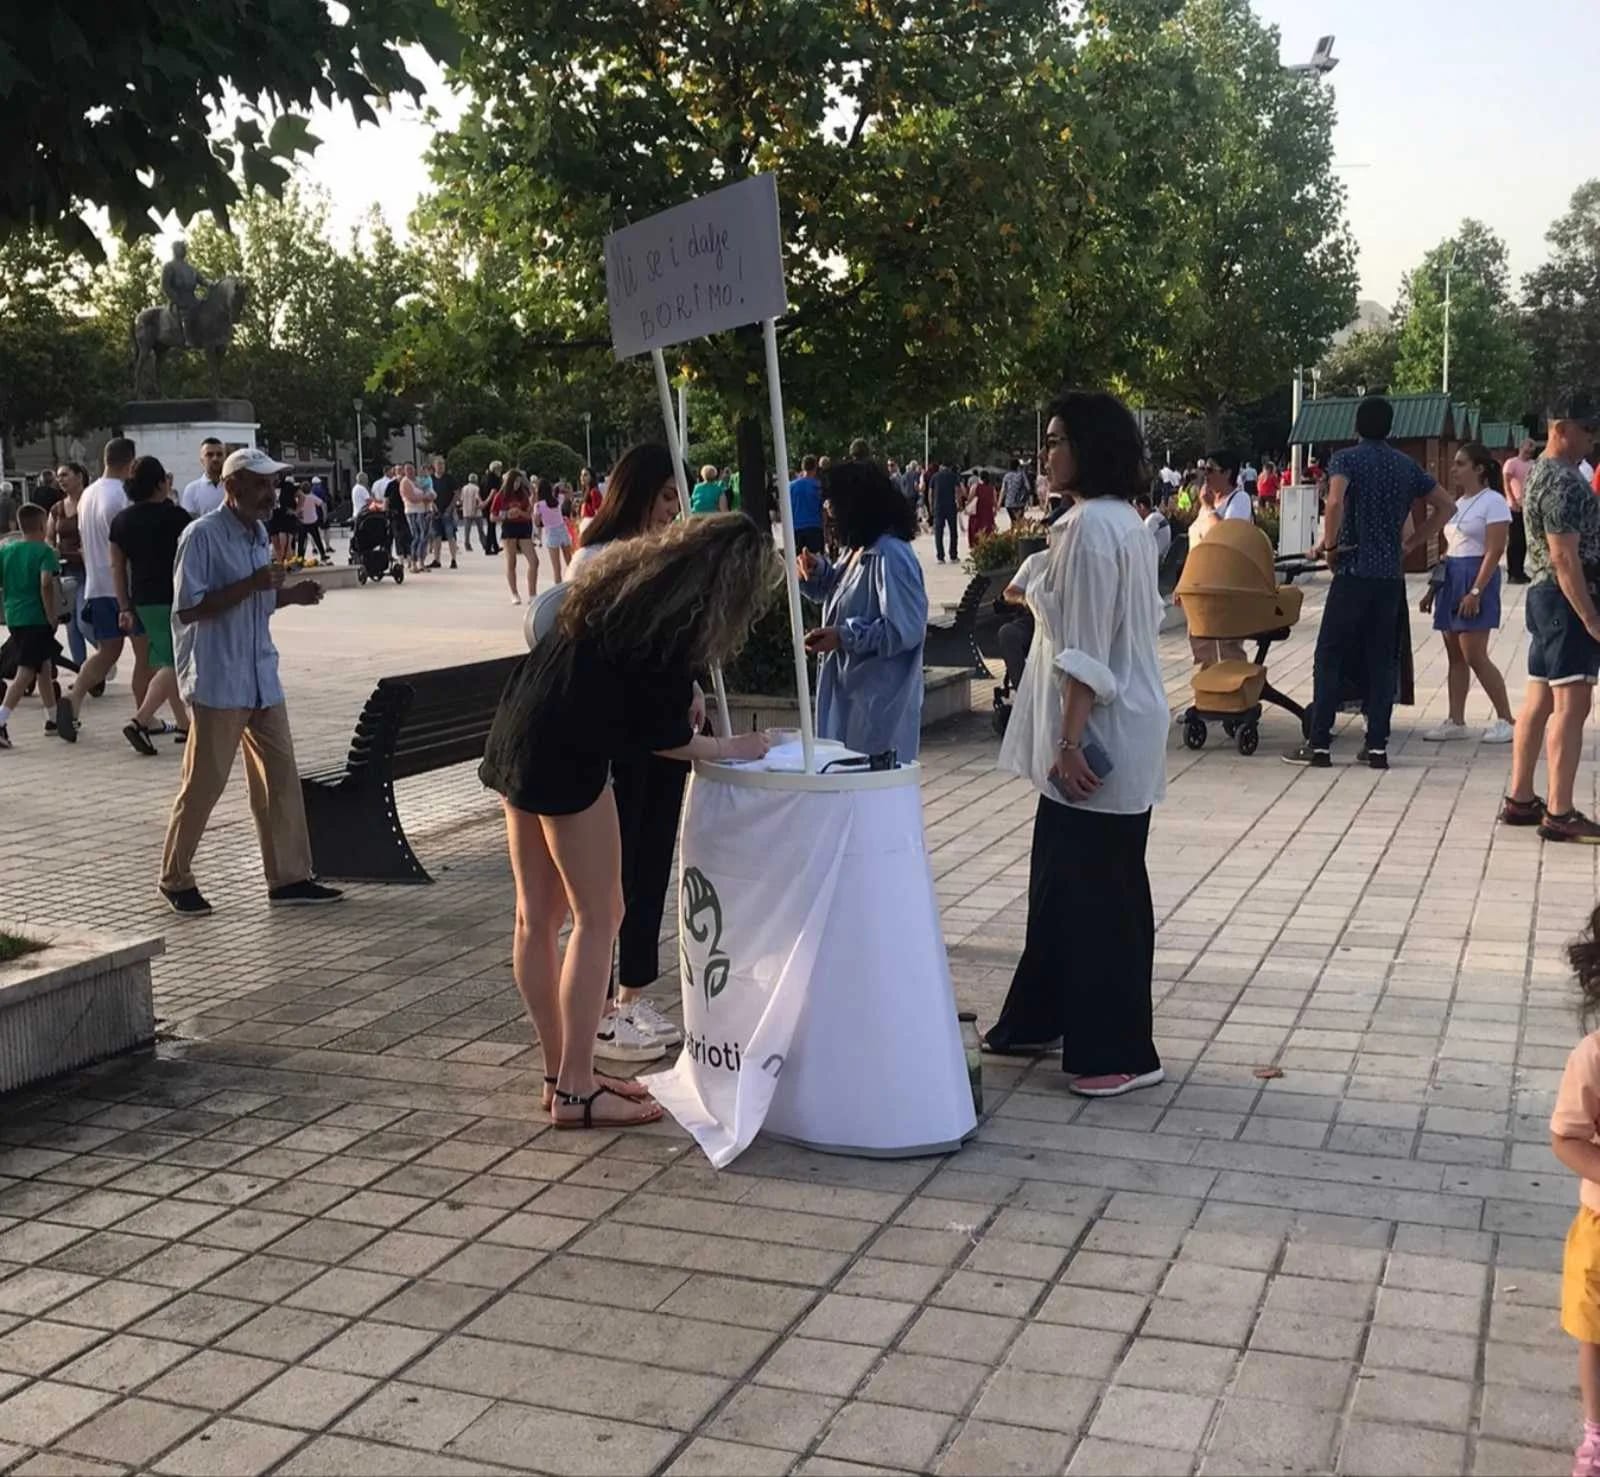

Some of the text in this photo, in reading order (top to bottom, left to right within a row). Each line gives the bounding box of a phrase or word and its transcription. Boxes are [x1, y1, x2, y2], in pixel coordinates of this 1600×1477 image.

[646, 249, 664, 283] se
[668, 236, 681, 268] i
[687, 222, 733, 272] dalje
[639, 255, 746, 341] BORIMO!
